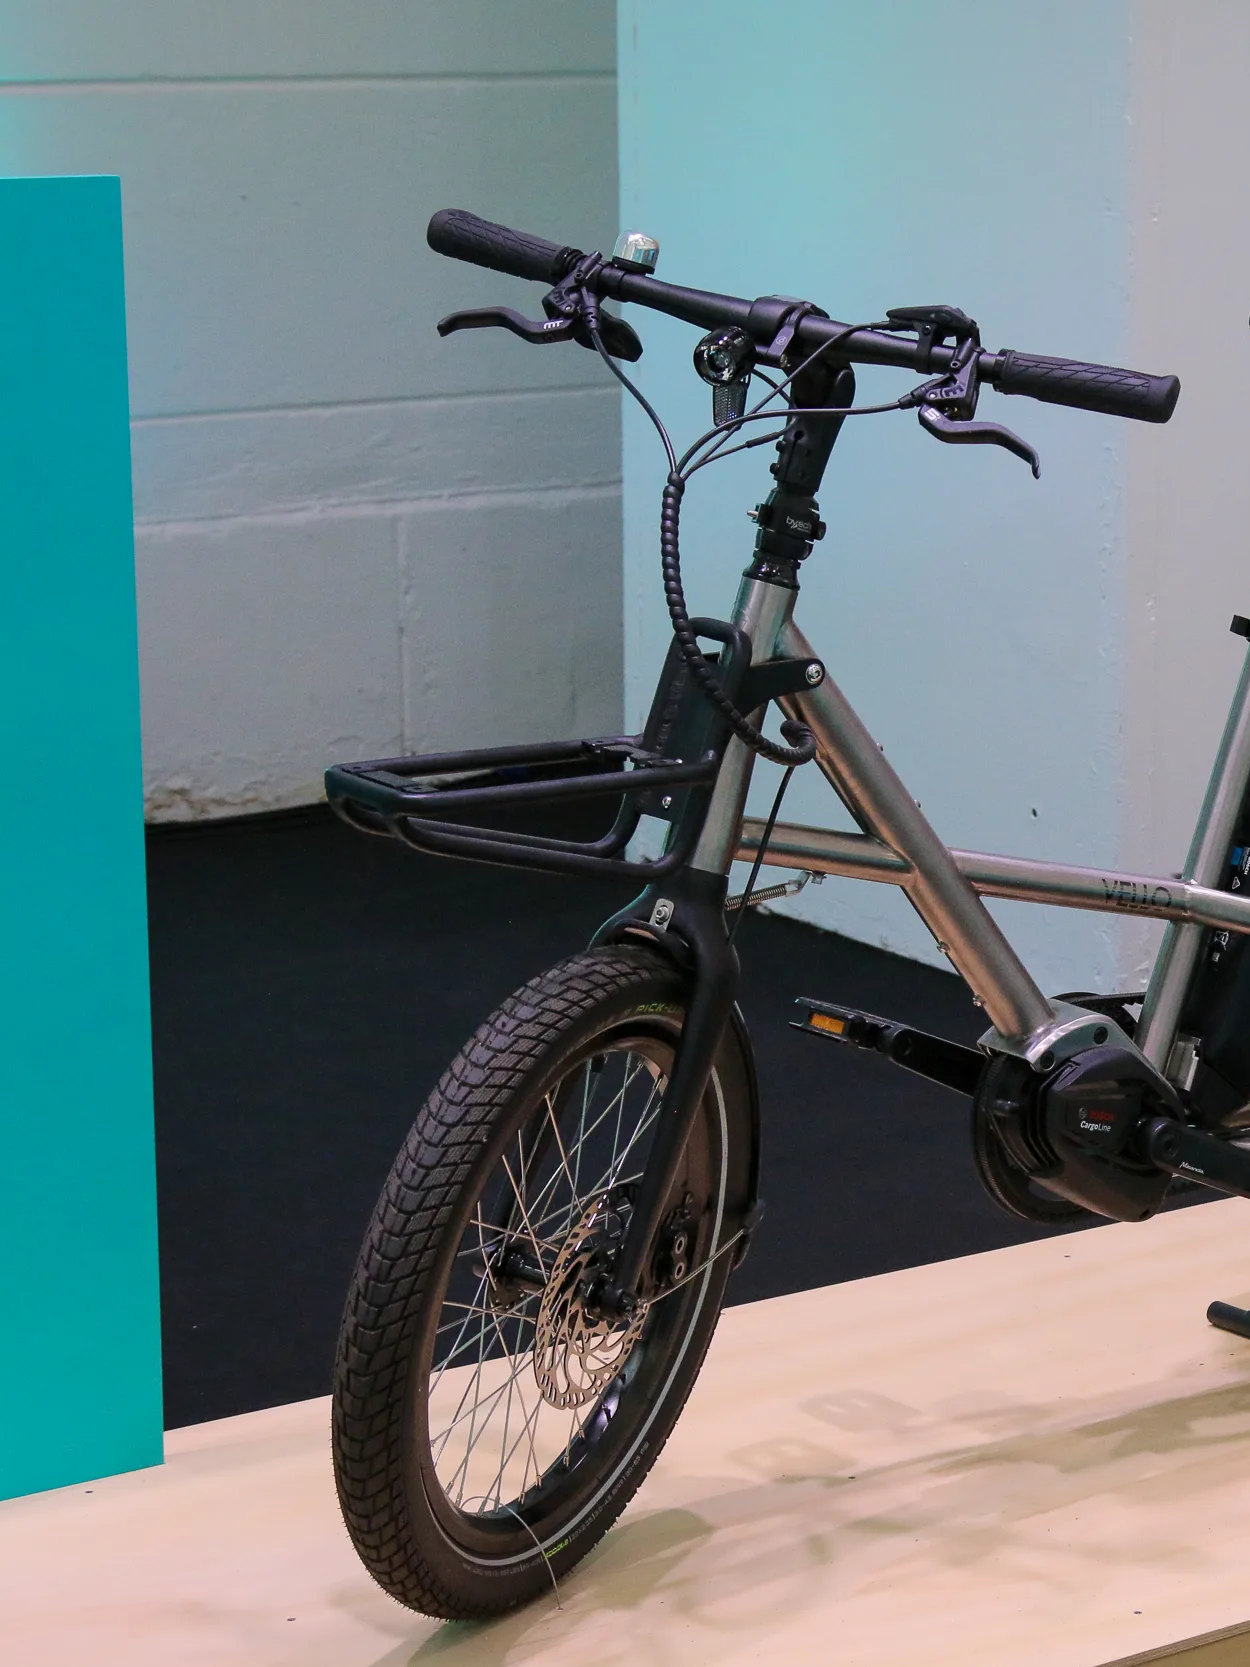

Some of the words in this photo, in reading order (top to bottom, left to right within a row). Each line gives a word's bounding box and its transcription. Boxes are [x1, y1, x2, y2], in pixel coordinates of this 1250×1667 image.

[543, 320, 563, 330] MT
[1101, 878, 1172, 912] VELLO
[1080, 1120, 1112, 1132] CargoLine
